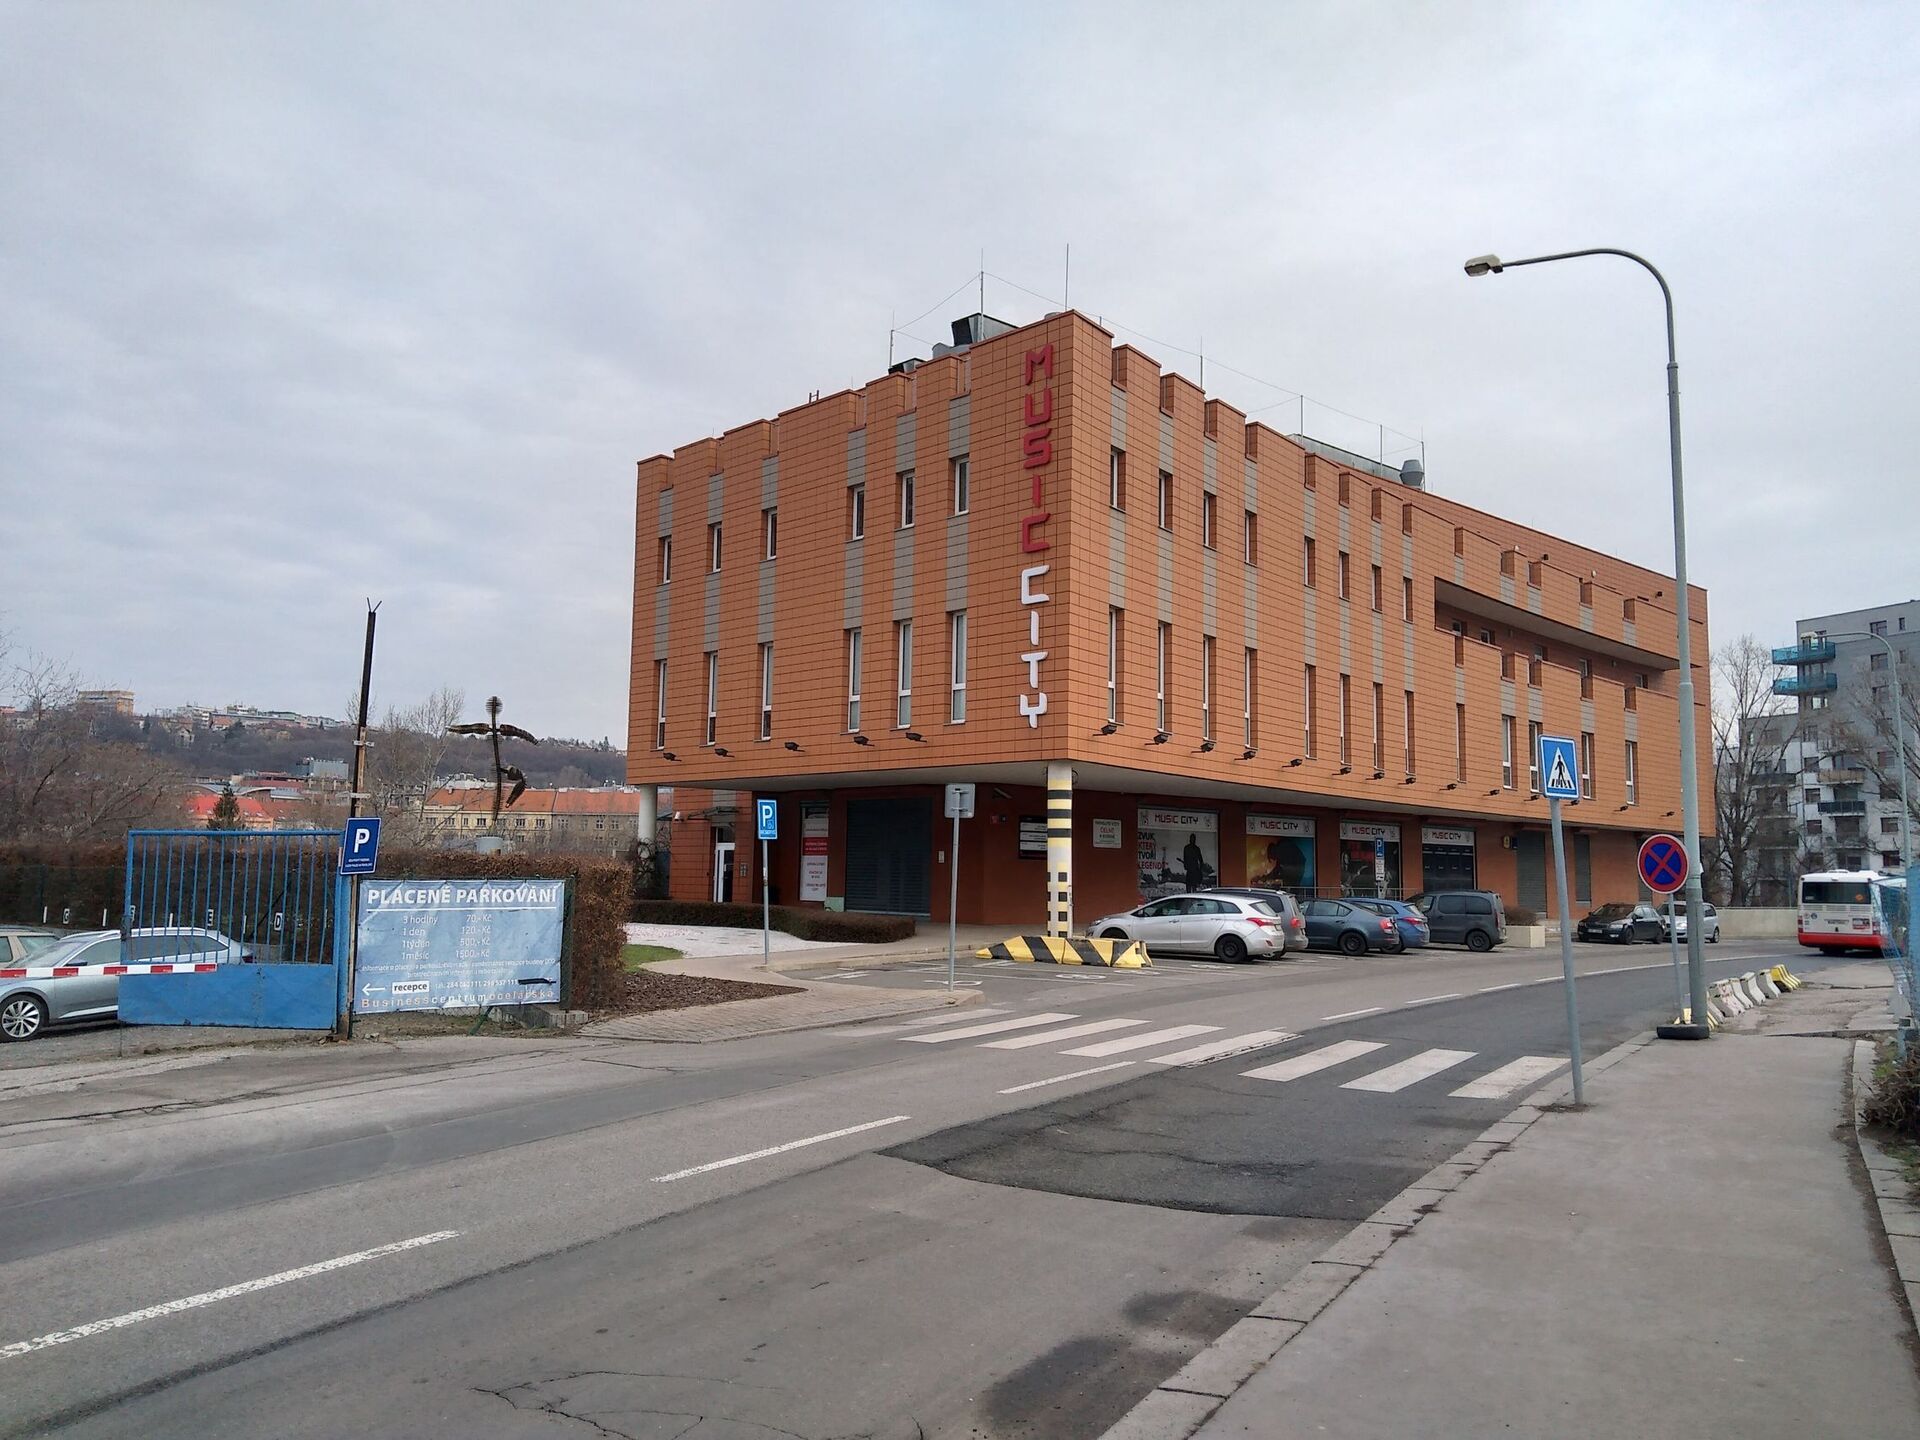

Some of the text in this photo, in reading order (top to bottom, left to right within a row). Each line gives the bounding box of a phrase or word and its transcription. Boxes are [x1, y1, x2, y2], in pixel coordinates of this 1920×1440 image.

[1022, 342, 1053, 553] MUSIC
[1018, 563, 1051, 730] CITY
[762, 805, 773, 827] P
[1154, 814, 1199, 825] MUSIC CITY
[1260, 820, 1299, 831] MUSIC CITY
[1351, 826, 1386, 835] MUSIC CITY
[354, 828, 370, 853] P
[367, 885, 556, 905] PLACENÉ PARKOVÁNÍ
[409, 927, 426, 936] den
[393, 983, 428, 993] recepce
